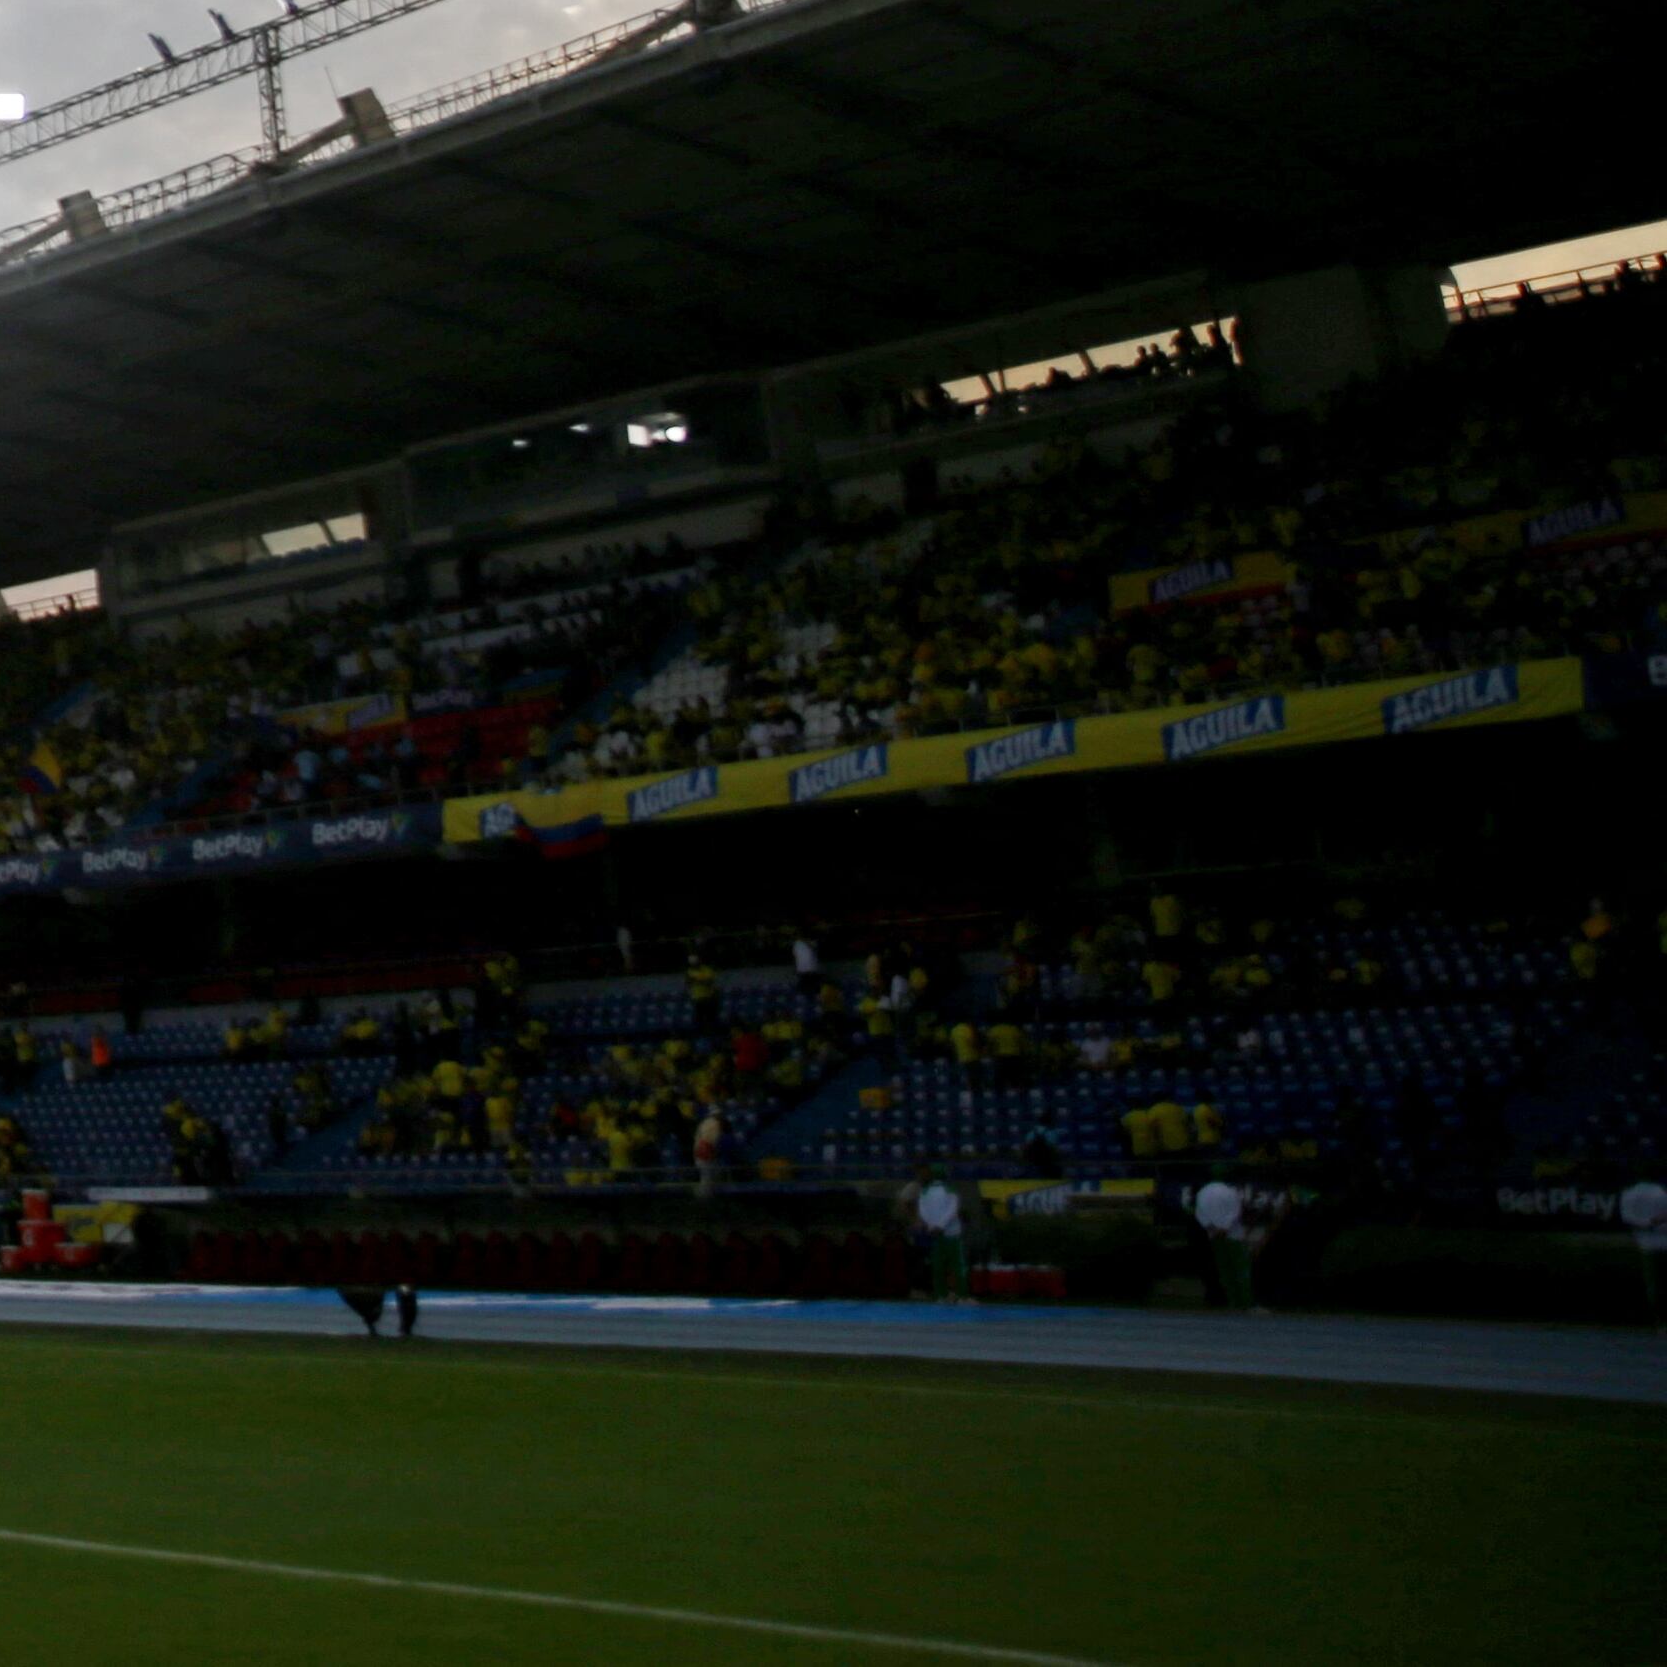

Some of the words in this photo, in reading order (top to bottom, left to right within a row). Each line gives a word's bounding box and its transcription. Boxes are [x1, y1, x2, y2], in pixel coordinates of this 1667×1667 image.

[1170, 695, 1277, 763] AGUILA
[1391, 667, 1511, 735] AGUILA
[794, 744, 886, 804] AGUILA
[973, 720, 1073, 783] AGUILA
[630, 766, 716, 825] AGUILA
[192, 833, 264, 862] BetPlay
[311, 815, 389, 847] BetPlay
[81, 847, 148, 875] BetPlay
